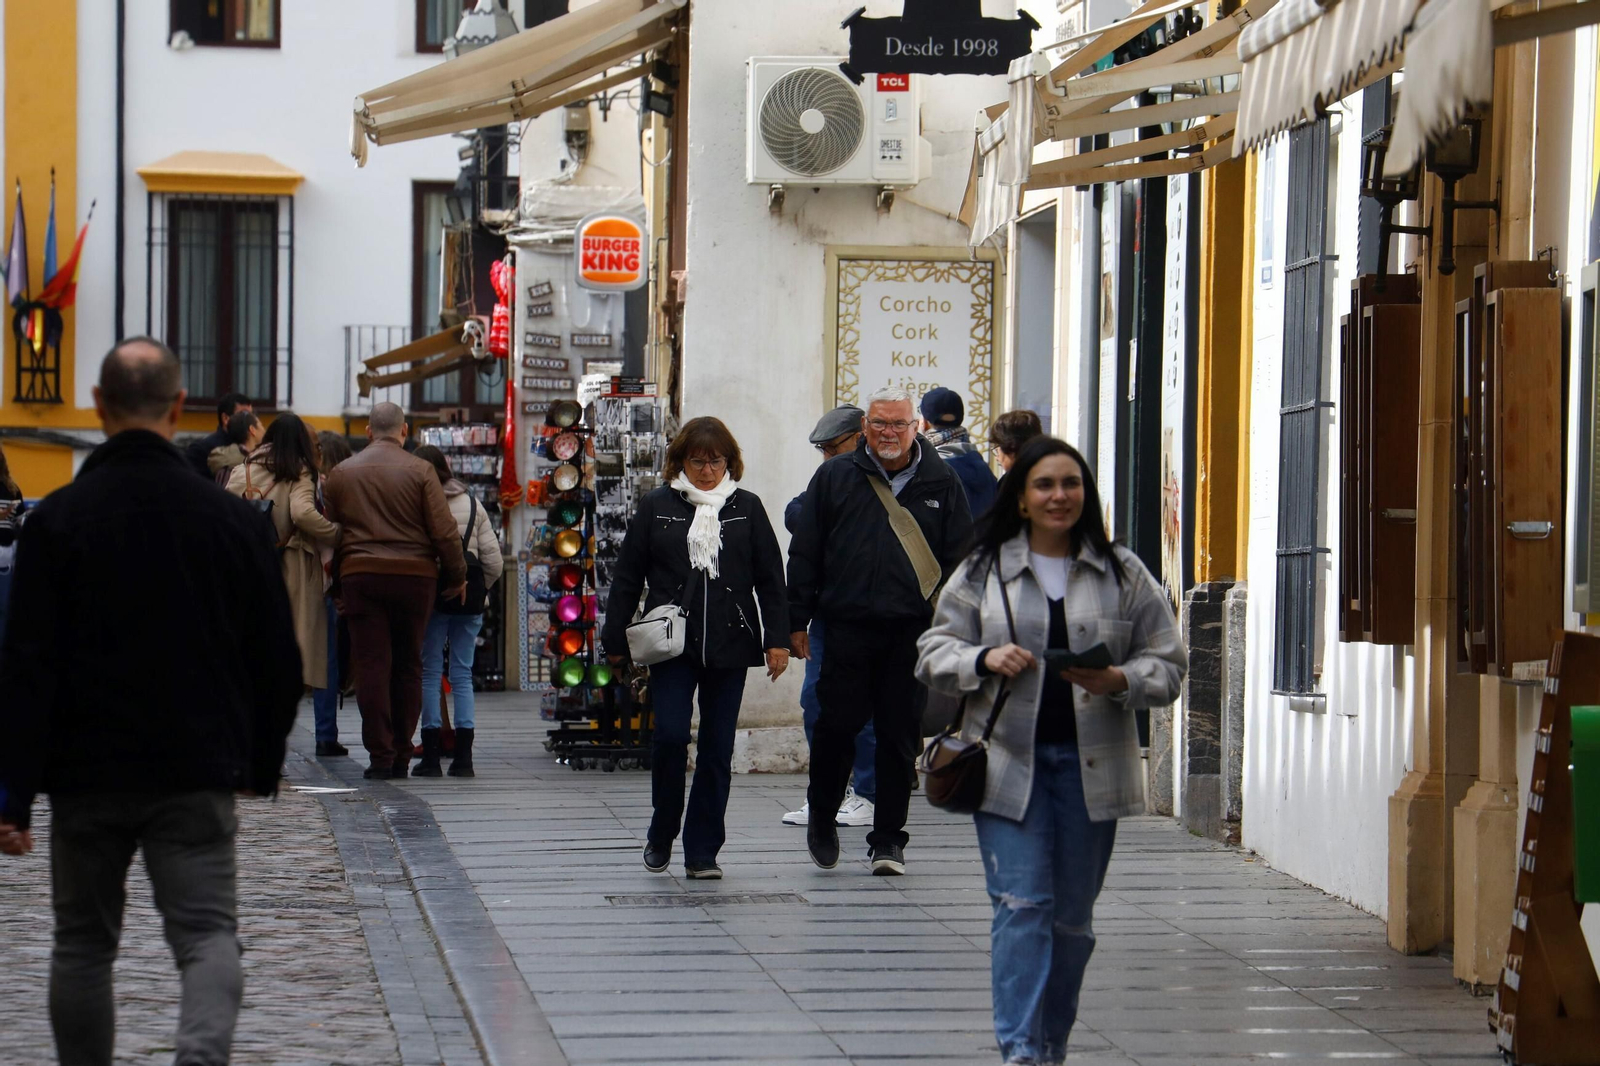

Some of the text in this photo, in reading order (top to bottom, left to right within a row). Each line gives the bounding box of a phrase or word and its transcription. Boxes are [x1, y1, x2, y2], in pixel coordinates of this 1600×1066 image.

[885, 37, 999, 57] Desde 1998
[881, 77, 905, 87] TCL
[582, 238, 640, 253] BURGER
[582, 253, 640, 272] KING
[880, 295, 951, 313] Corcho
[891, 323, 939, 340] Cork
[891, 350, 938, 368] Kork
